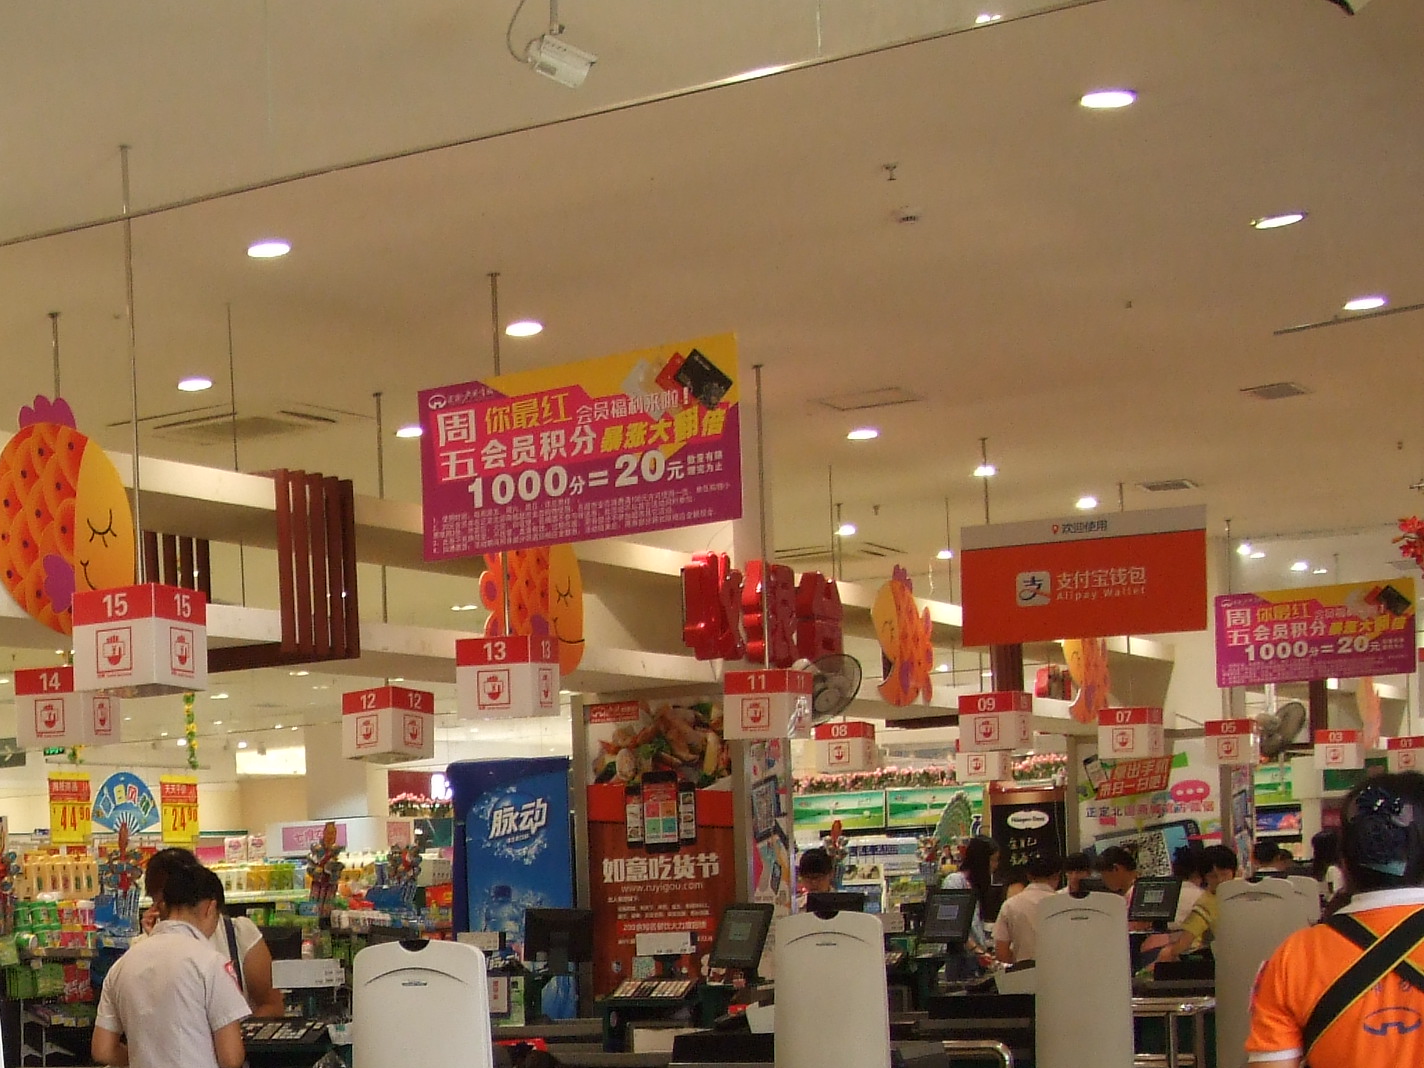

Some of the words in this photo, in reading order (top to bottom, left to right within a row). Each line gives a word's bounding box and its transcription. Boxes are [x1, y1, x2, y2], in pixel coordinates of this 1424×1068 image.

[485, 393, 573, 434] 你最红
[481, 426, 596, 469] 会员积分
[1056, 567, 1147, 591] 支付宝钱包
[102, 593, 129, 618] 15
[173, 594, 192, 618] 15
[1253, 620, 1326, 641] 会员积分
[483, 641, 506, 661] 13
[39, 672, 61, 691] 14
[747, 674, 766, 690] 11
[360, 693, 376, 710] 12
[407, 693, 422, 709] 12
[978, 697, 995, 711] 09
[1116, 710, 1132, 723] 07
[831, 724, 848, 737] 08
[489, 797, 548, 840] 脉动
[602, 852, 720, 884] 如意吃货节
